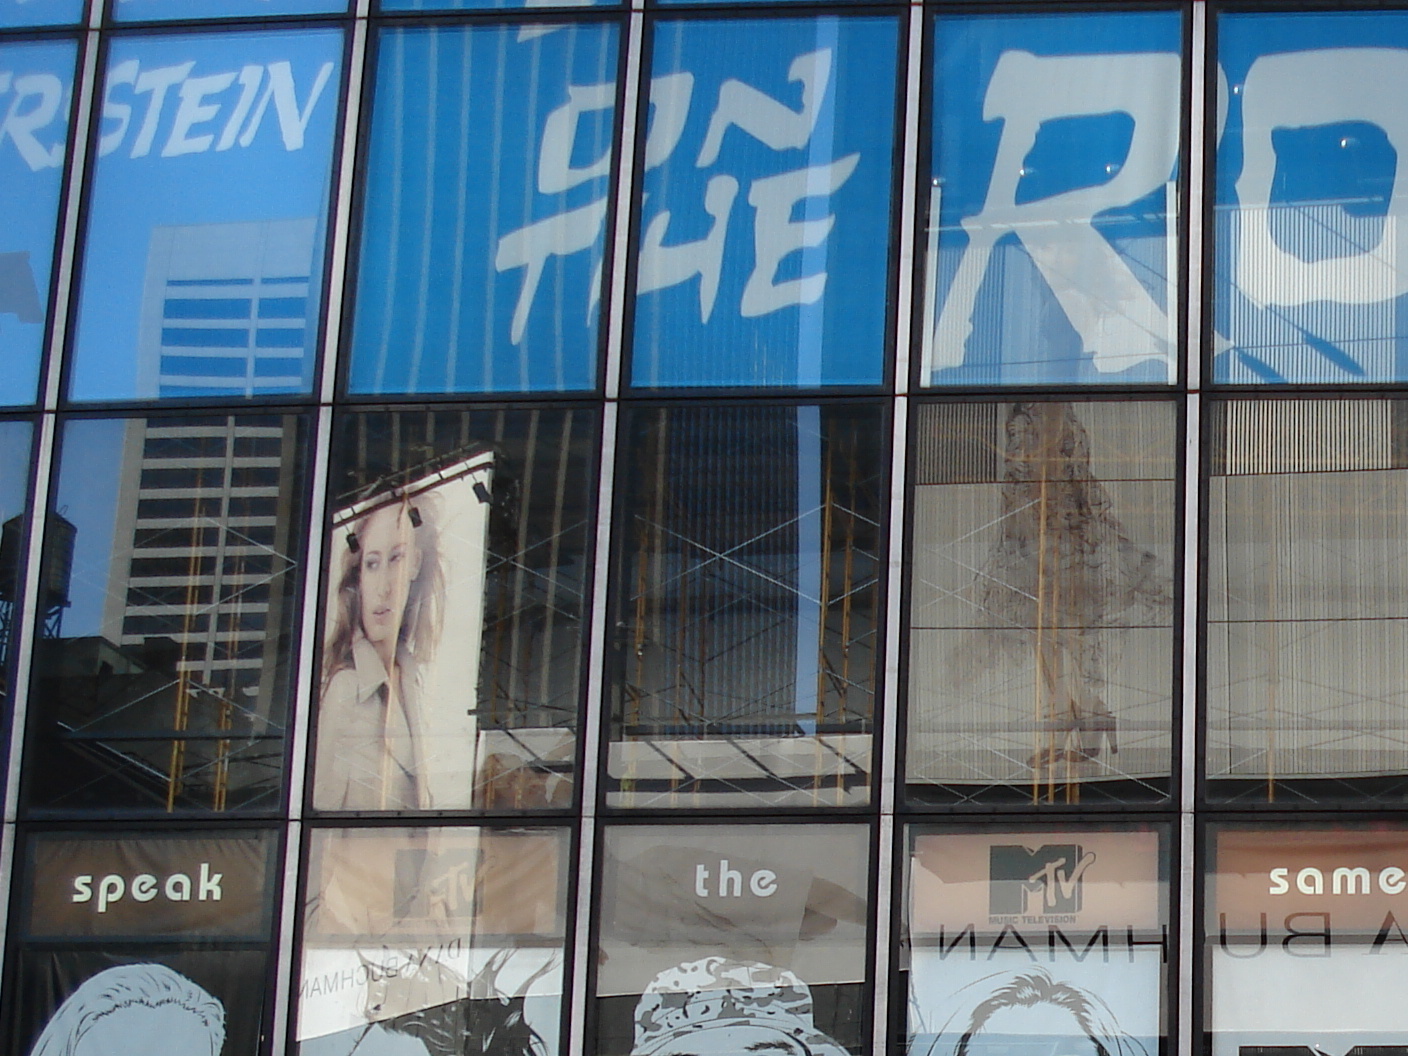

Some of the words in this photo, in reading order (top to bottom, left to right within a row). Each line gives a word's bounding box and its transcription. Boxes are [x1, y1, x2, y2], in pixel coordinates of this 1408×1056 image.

[0, 59, 335, 172] RSTEIN
[537, 48, 832, 194] ON
[495, 152, 861, 346] THE
[72, 863, 223, 912] speak
[695, 859, 778, 898] the
[1269, 866, 1407, 895] same
[988, 915, 1019, 925] MUSIC
[1022, 915, 1077, 924] TELEVISION
[989, 844, 1097, 915] MTV
